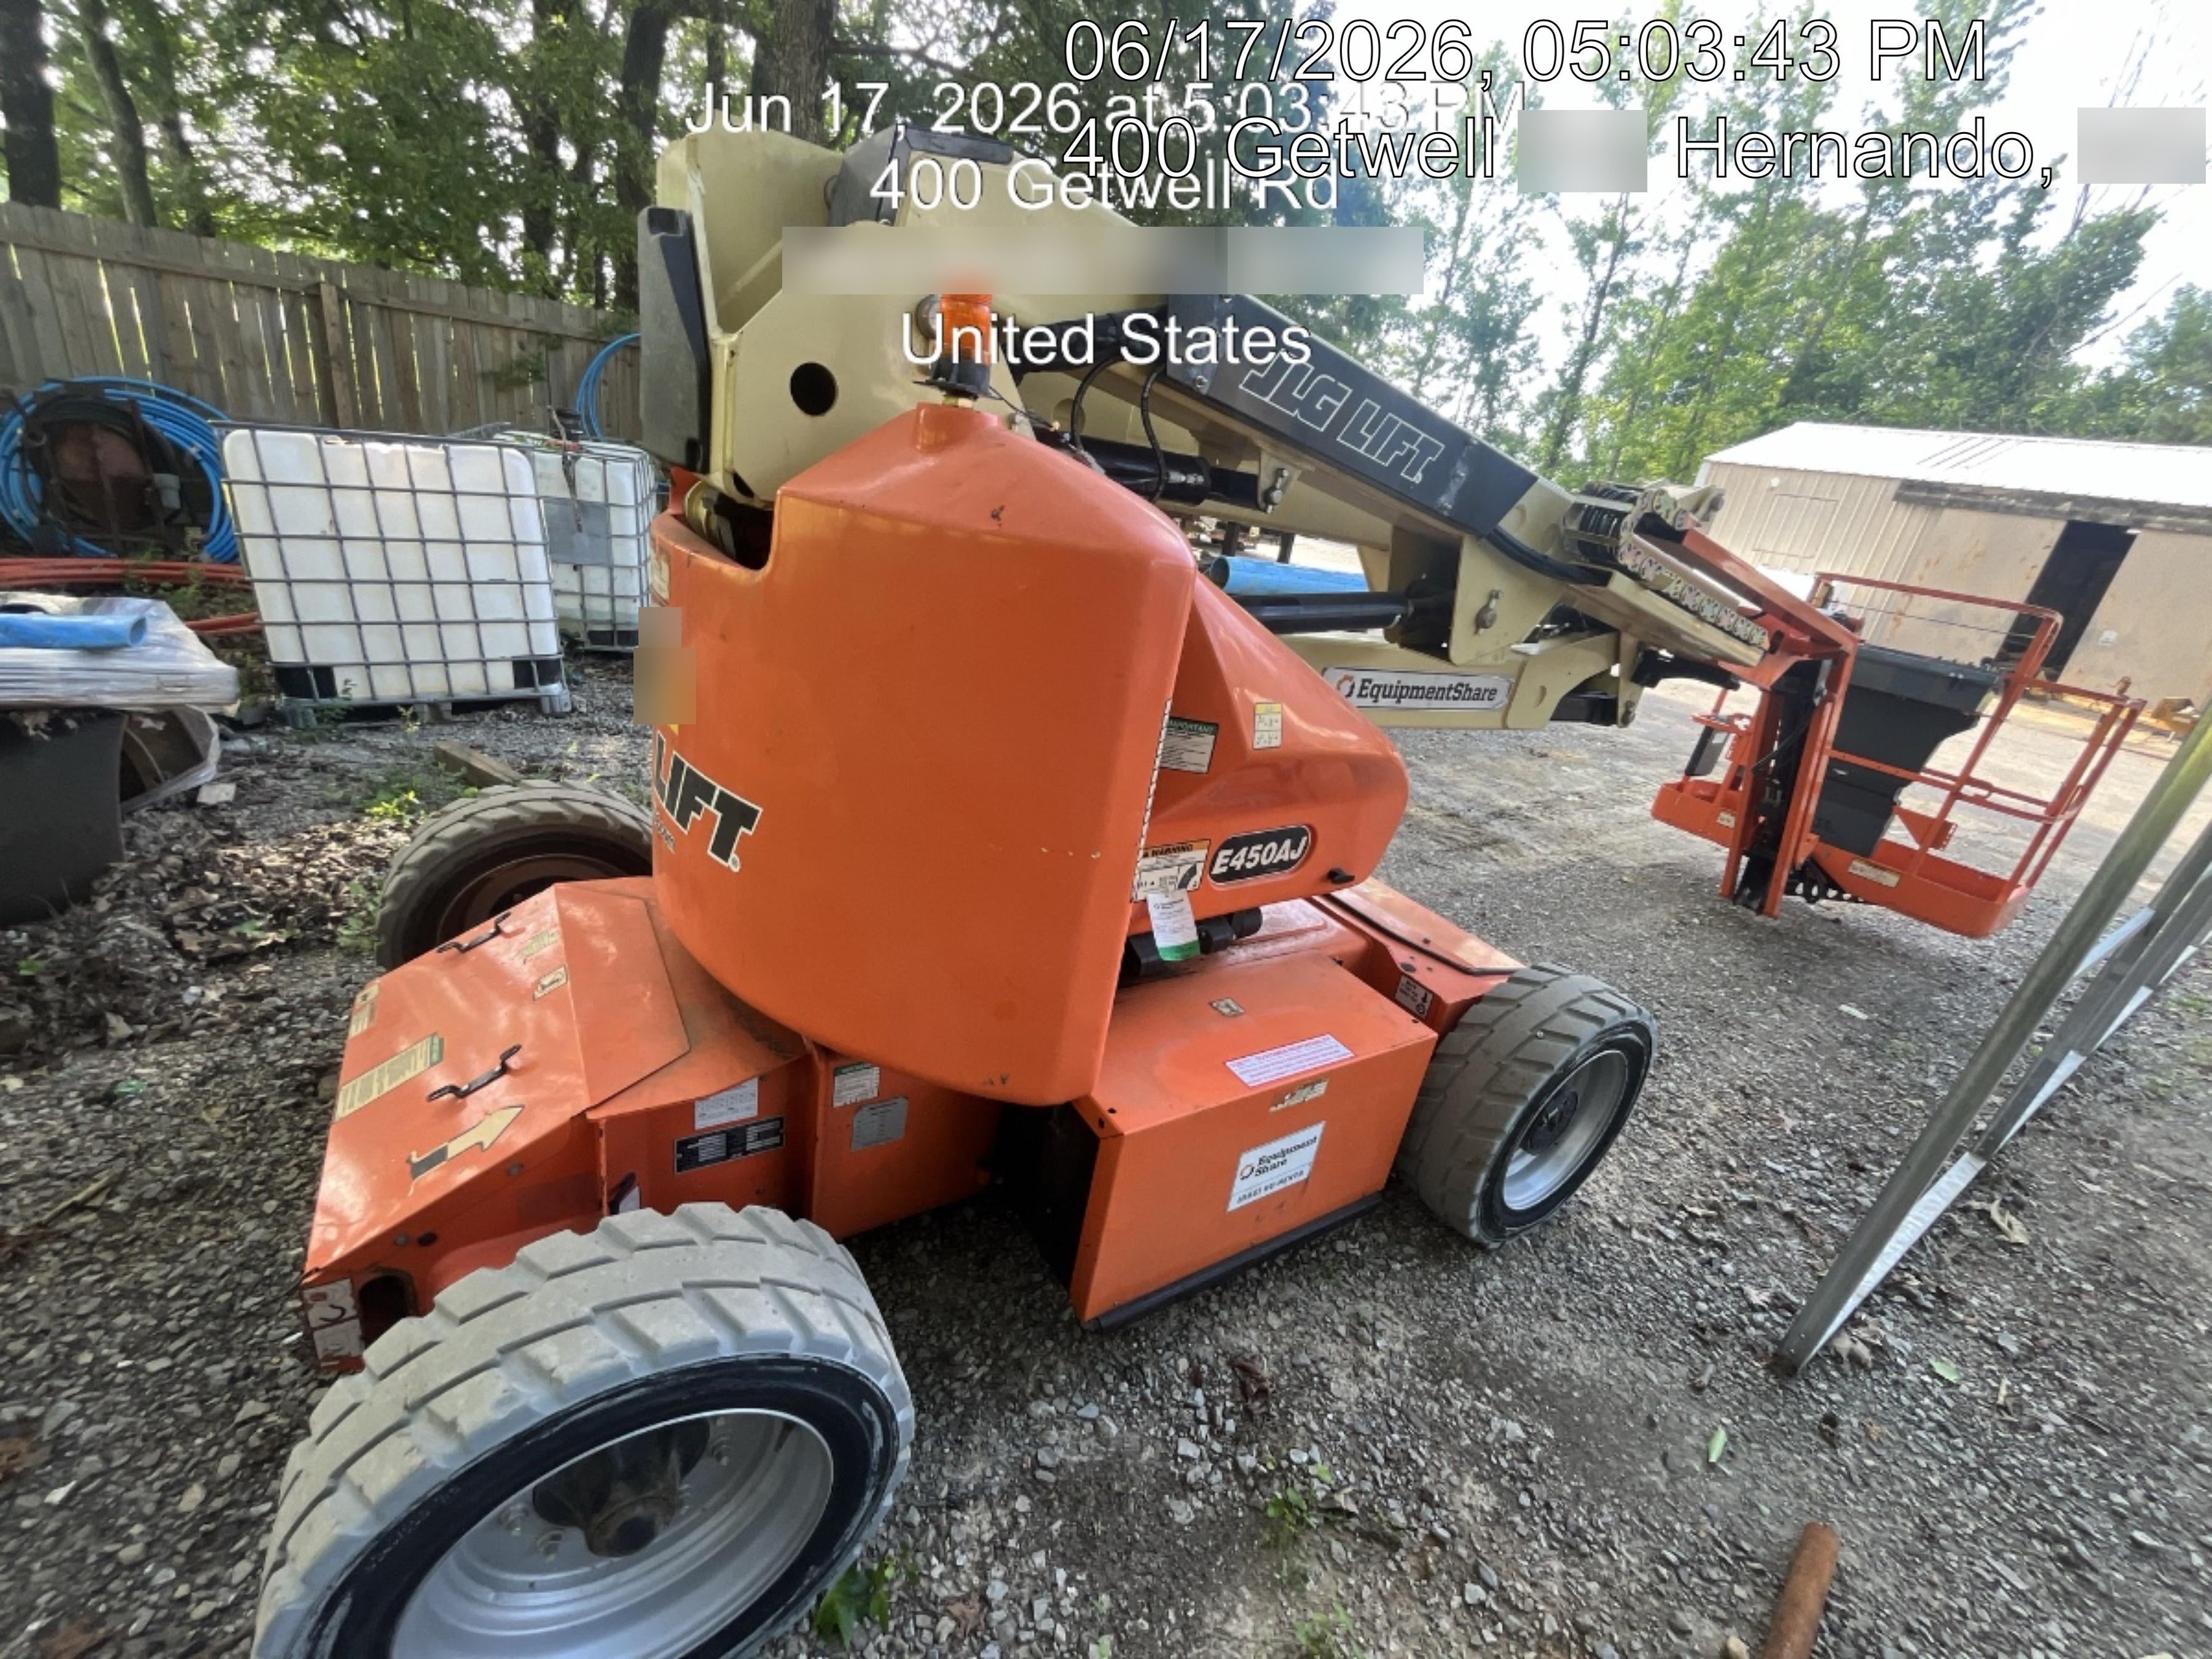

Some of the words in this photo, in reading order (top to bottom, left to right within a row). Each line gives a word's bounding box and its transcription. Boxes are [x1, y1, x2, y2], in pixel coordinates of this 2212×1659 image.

[1239, 349, 1353, 432] JLG
[1336, 398, 1446, 483] LIFT
[1357, 678, 1498, 704] EquipmentShare
[653, 729, 764, 869] LIFT
[1211, 836, 1308, 874] E450AJ
